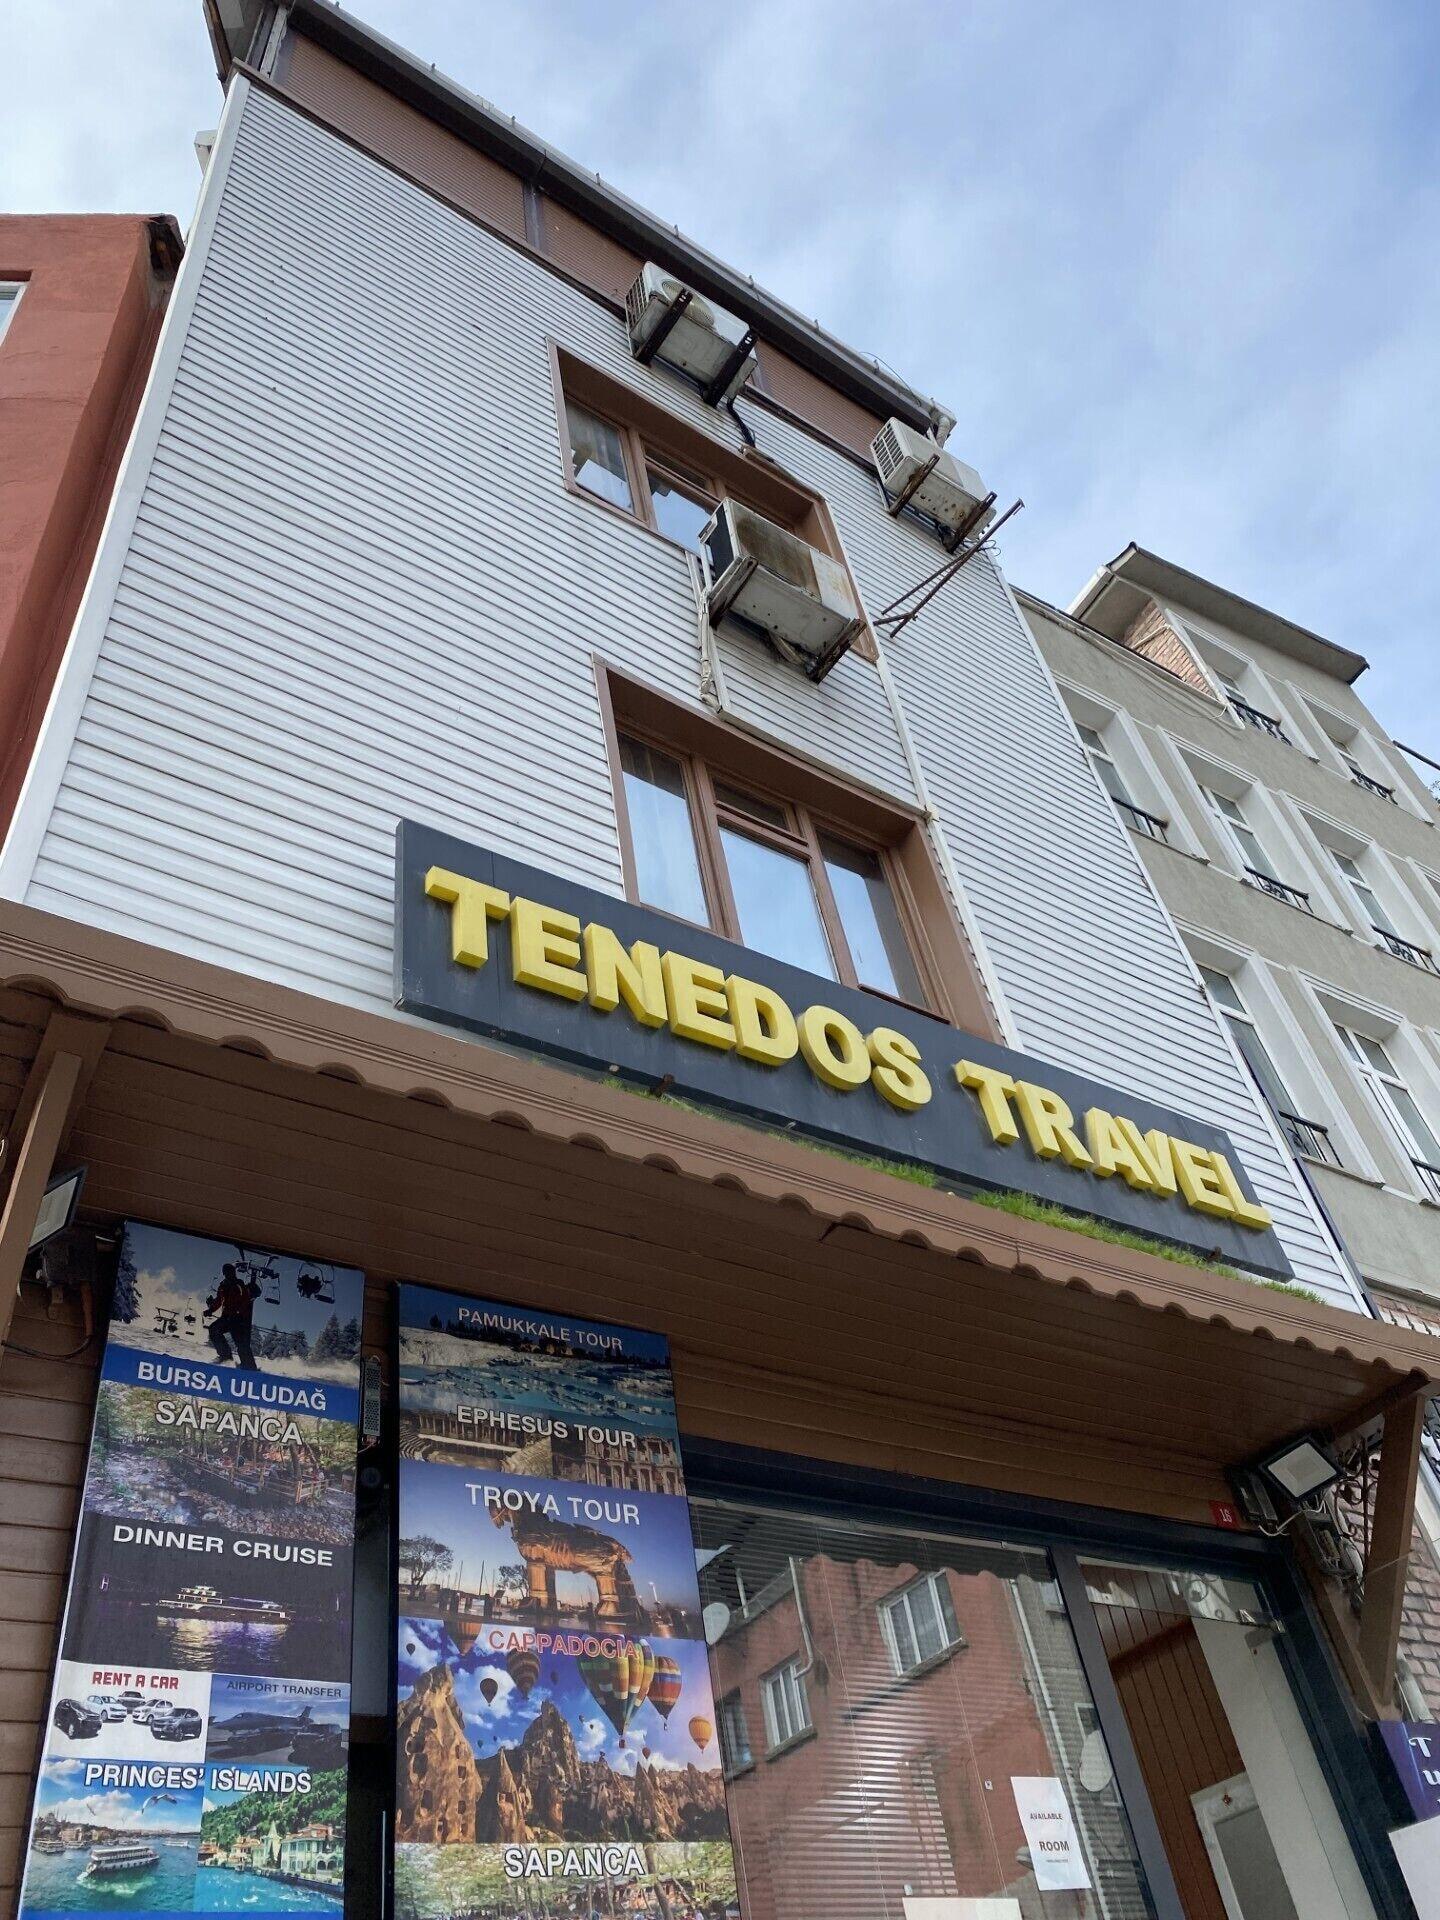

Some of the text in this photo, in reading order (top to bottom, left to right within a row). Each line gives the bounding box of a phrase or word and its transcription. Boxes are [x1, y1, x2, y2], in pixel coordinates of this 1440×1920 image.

[424, 865, 1273, 1231] TENEDOS TRAVEL
[457, 1307, 623, 1351] PAMUKKALE TOUR
[137, 1361, 327, 1411] BURSA ULUDAĞ
[155, 1400, 304, 1446] SAPANCA
[456, 1404, 637, 1448] EPHESUS TOUR
[464, 1483, 640, 1526] TROYA TOUR
[113, 1524, 333, 1567] DINNER CRUISE
[488, 1630, 640, 1660] CAPPADOCIA
[92, 1671, 179, 1690] RENT A CAR
[226, 1680, 342, 1698] AIRPORT TRANSFER
[210, 1768, 313, 1793] ISLANDS
[1030, 1812, 1063, 1821] AVAILABLE
[503, 1847, 646, 1878] SAPANCA
[1039, 1841, 1070, 1852] ROOM
